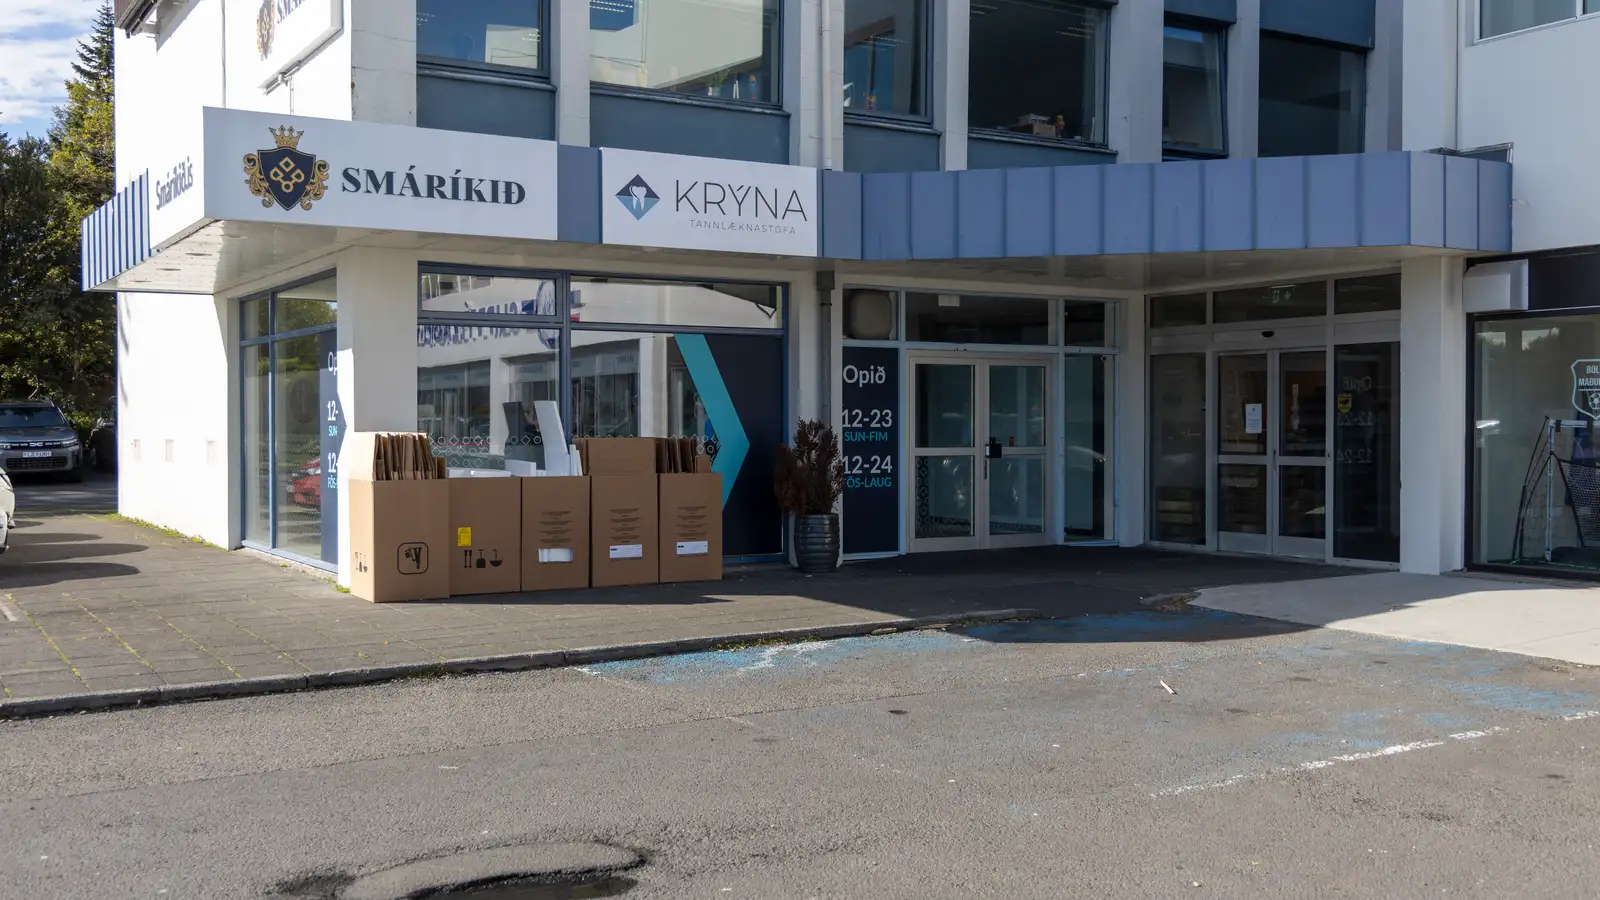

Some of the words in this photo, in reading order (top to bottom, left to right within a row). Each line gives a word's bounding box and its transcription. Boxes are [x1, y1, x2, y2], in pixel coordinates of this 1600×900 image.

[342, 165, 526, 205] SMÁRÍKIÐ
[676, 179, 807, 221] KRÝNA
[690, 219, 796, 234] TANNLÆKNASTOFA
[842, 364, 886, 388] Opið
[842, 409, 892, 428] 12-23
[844, 431, 888, 442] SUN-FIM
[842, 455, 892, 474] 12-24
[845, 475, 892, 488] ÖS-LAUG
